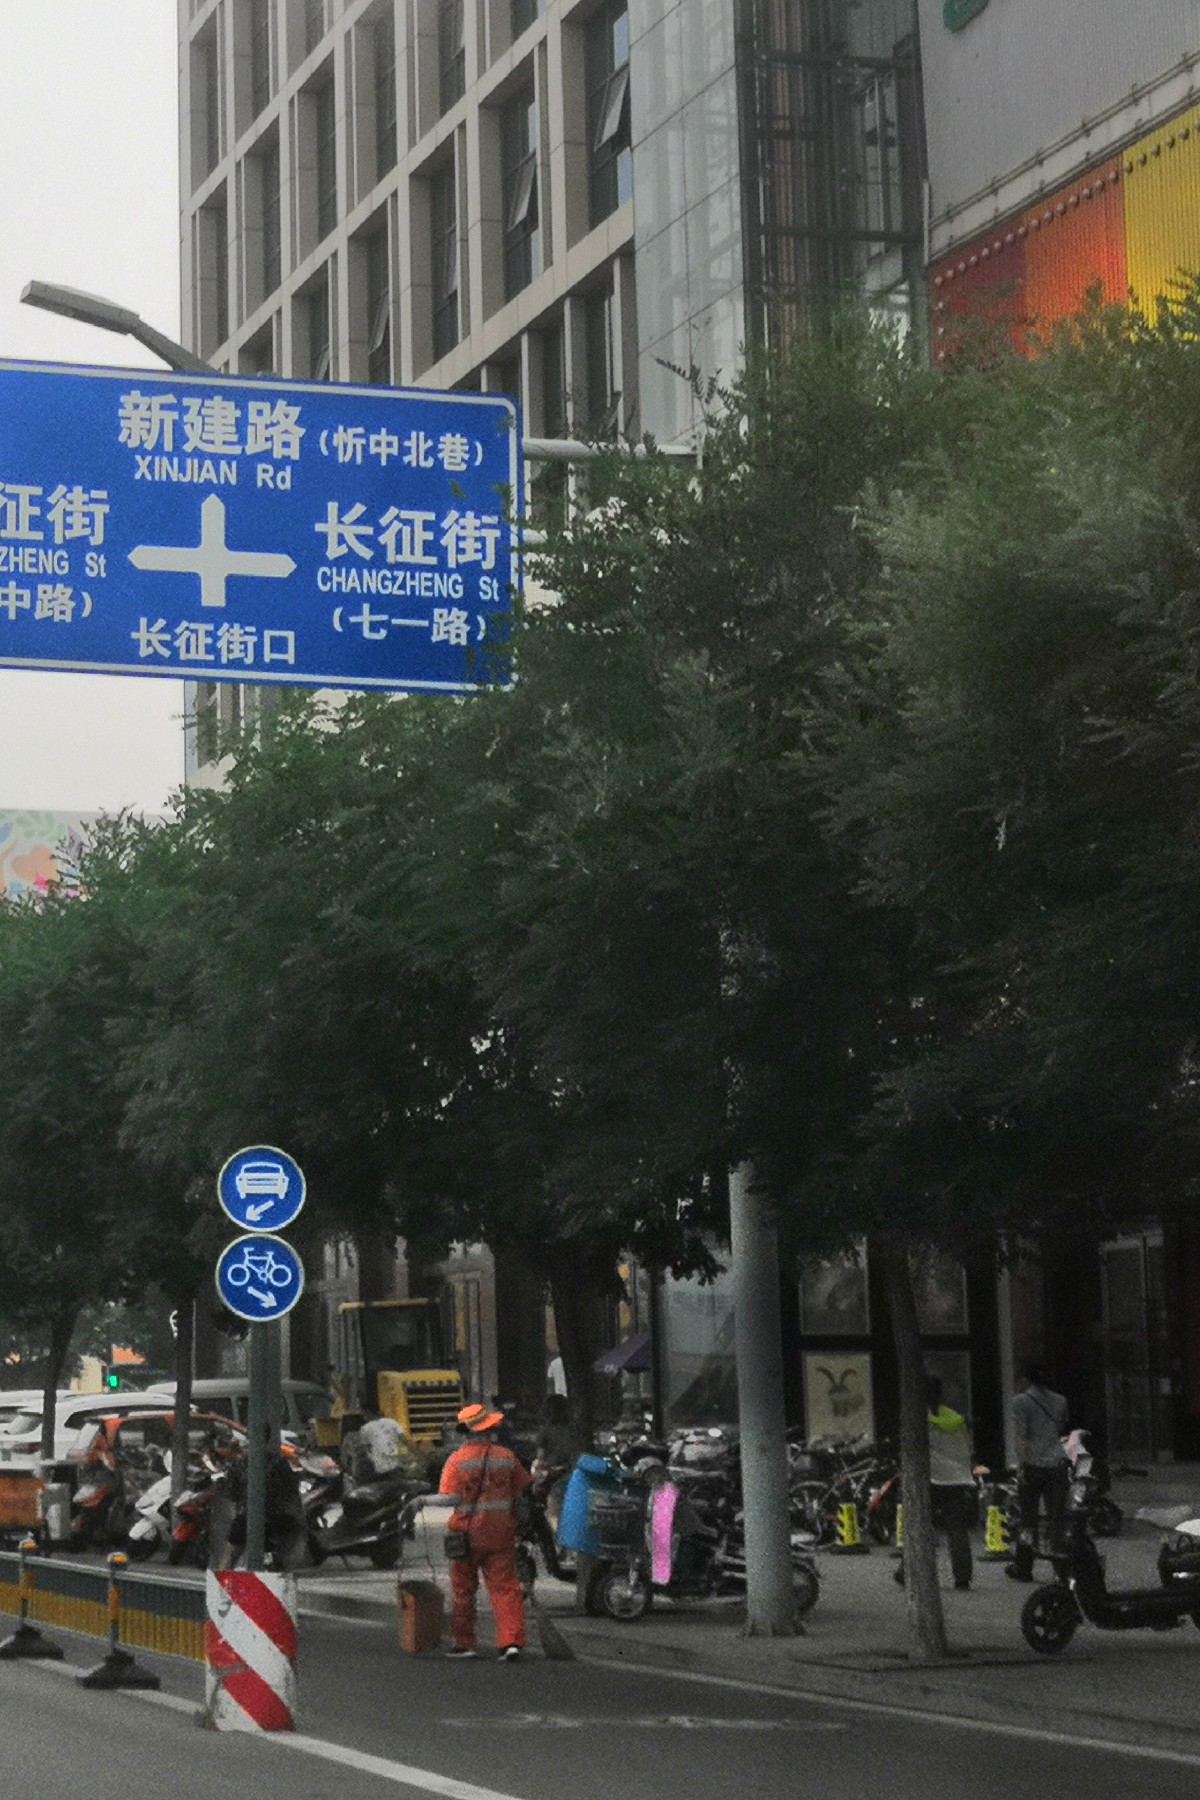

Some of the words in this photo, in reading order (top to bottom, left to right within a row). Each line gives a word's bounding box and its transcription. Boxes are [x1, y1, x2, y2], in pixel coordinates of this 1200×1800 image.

[118, 390, 306, 460] 新建路
[319, 425, 483, 472] (忻中北巷)
[134, 454, 237, 486] XINJIAN
[256, 462, 292, 490] Rd
[314, 501, 500, 570] 长征街
[85, 552, 107, 578] St
[316, 566, 464, 599] CHANGZHENG
[478, 576, 499, 602] St
[130, 617, 295, 665] 长征街口
[332, 602, 487, 646] (七一路)
